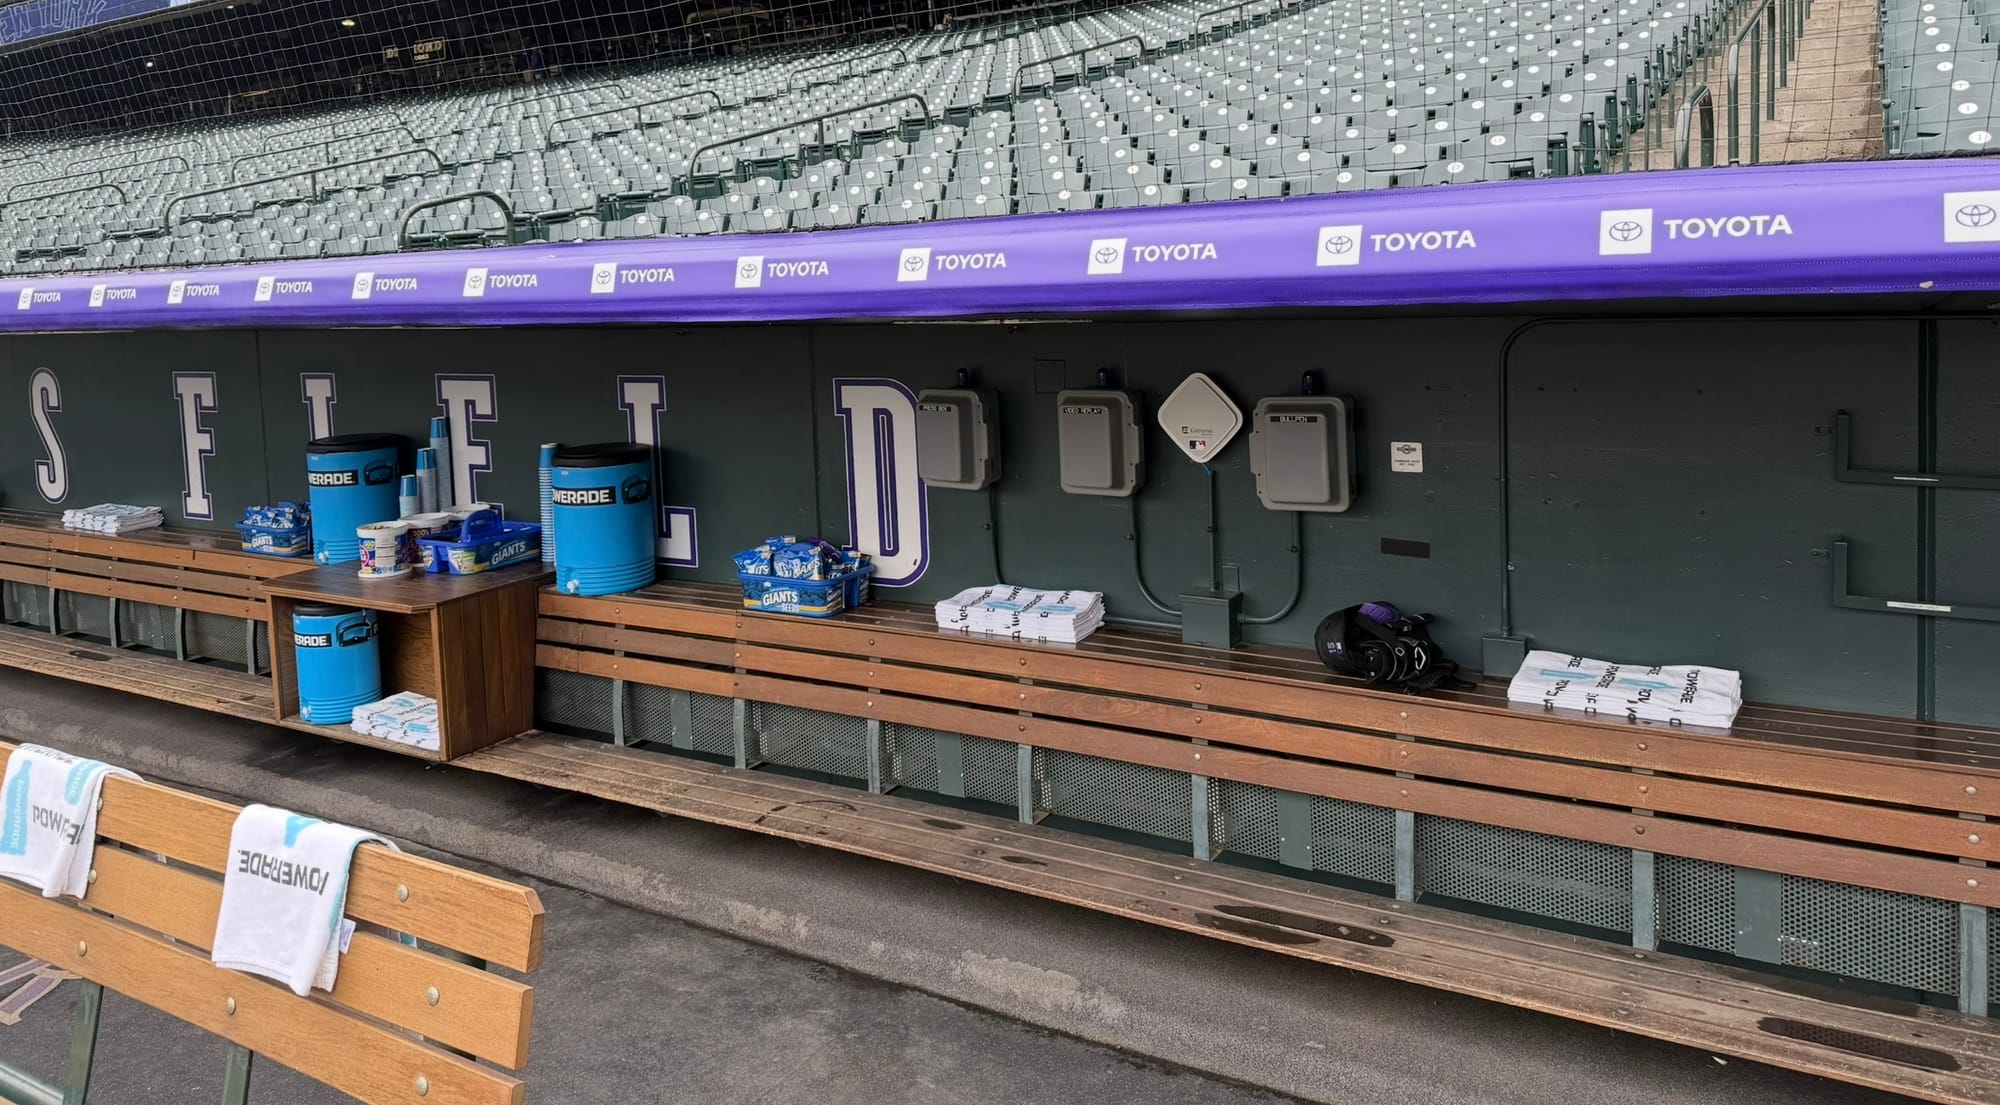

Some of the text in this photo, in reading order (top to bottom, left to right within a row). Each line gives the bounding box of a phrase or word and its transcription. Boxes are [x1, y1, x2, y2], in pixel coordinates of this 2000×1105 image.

[1663, 214, 1793, 240] TOYOTA
[1370, 229, 1476, 253] TOYOTA
[1132, 242, 1218, 263] TOYOTA
[768, 260, 829, 278] TOYOTA
[935, 251, 1007, 271] TOYOTA
[374, 276, 418, 291] TOYOTA
[490, 273, 538, 289] TOYOTA
[620, 267, 675, 284] TOYOTA
[106, 287, 137, 300] TOYOTA
[186, 283, 220, 297] TOYOTA
[275, 280, 313, 294] TOYOTA
[33, 290, 61, 303] TOYOTA
[252, 535, 273, 548] GIANTS
[491, 541, 526, 565] GIANTS
[762, 590, 798, 606] GIANTS
